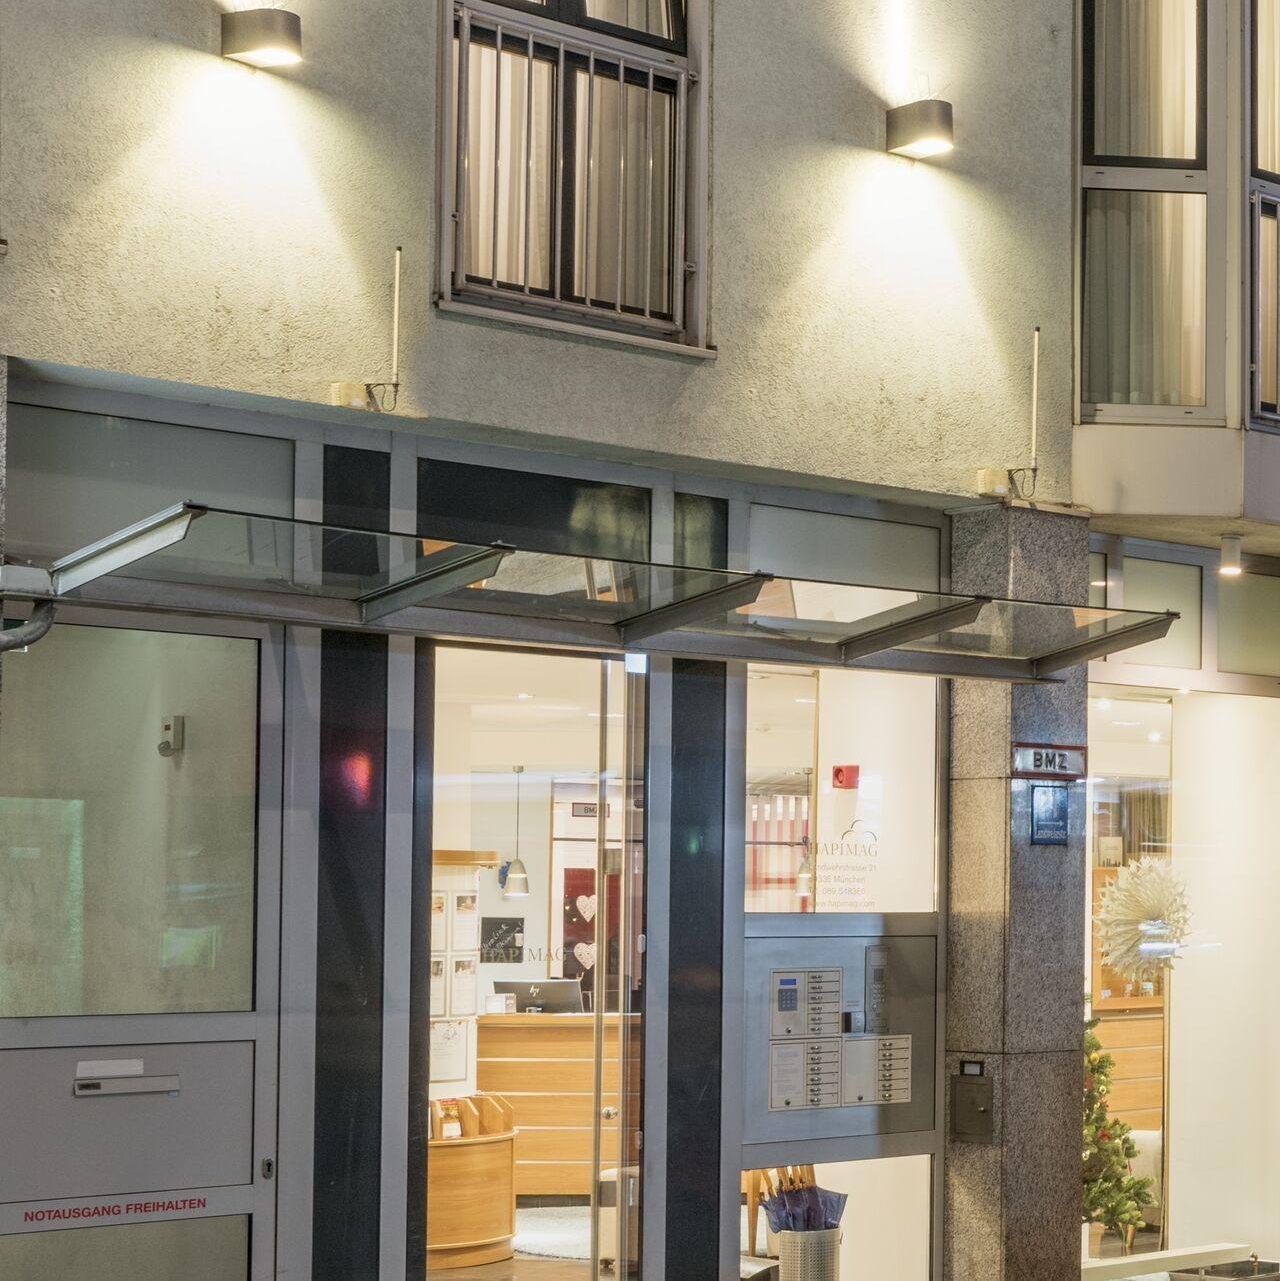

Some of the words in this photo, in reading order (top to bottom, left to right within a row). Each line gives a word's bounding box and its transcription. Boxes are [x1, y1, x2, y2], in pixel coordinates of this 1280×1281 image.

[1033, 751, 1067, 770] BMZ
[24, 1205, 121, 1222] NOTAUSGANG
[125, 1198, 206, 1214] FREIHALTEN
